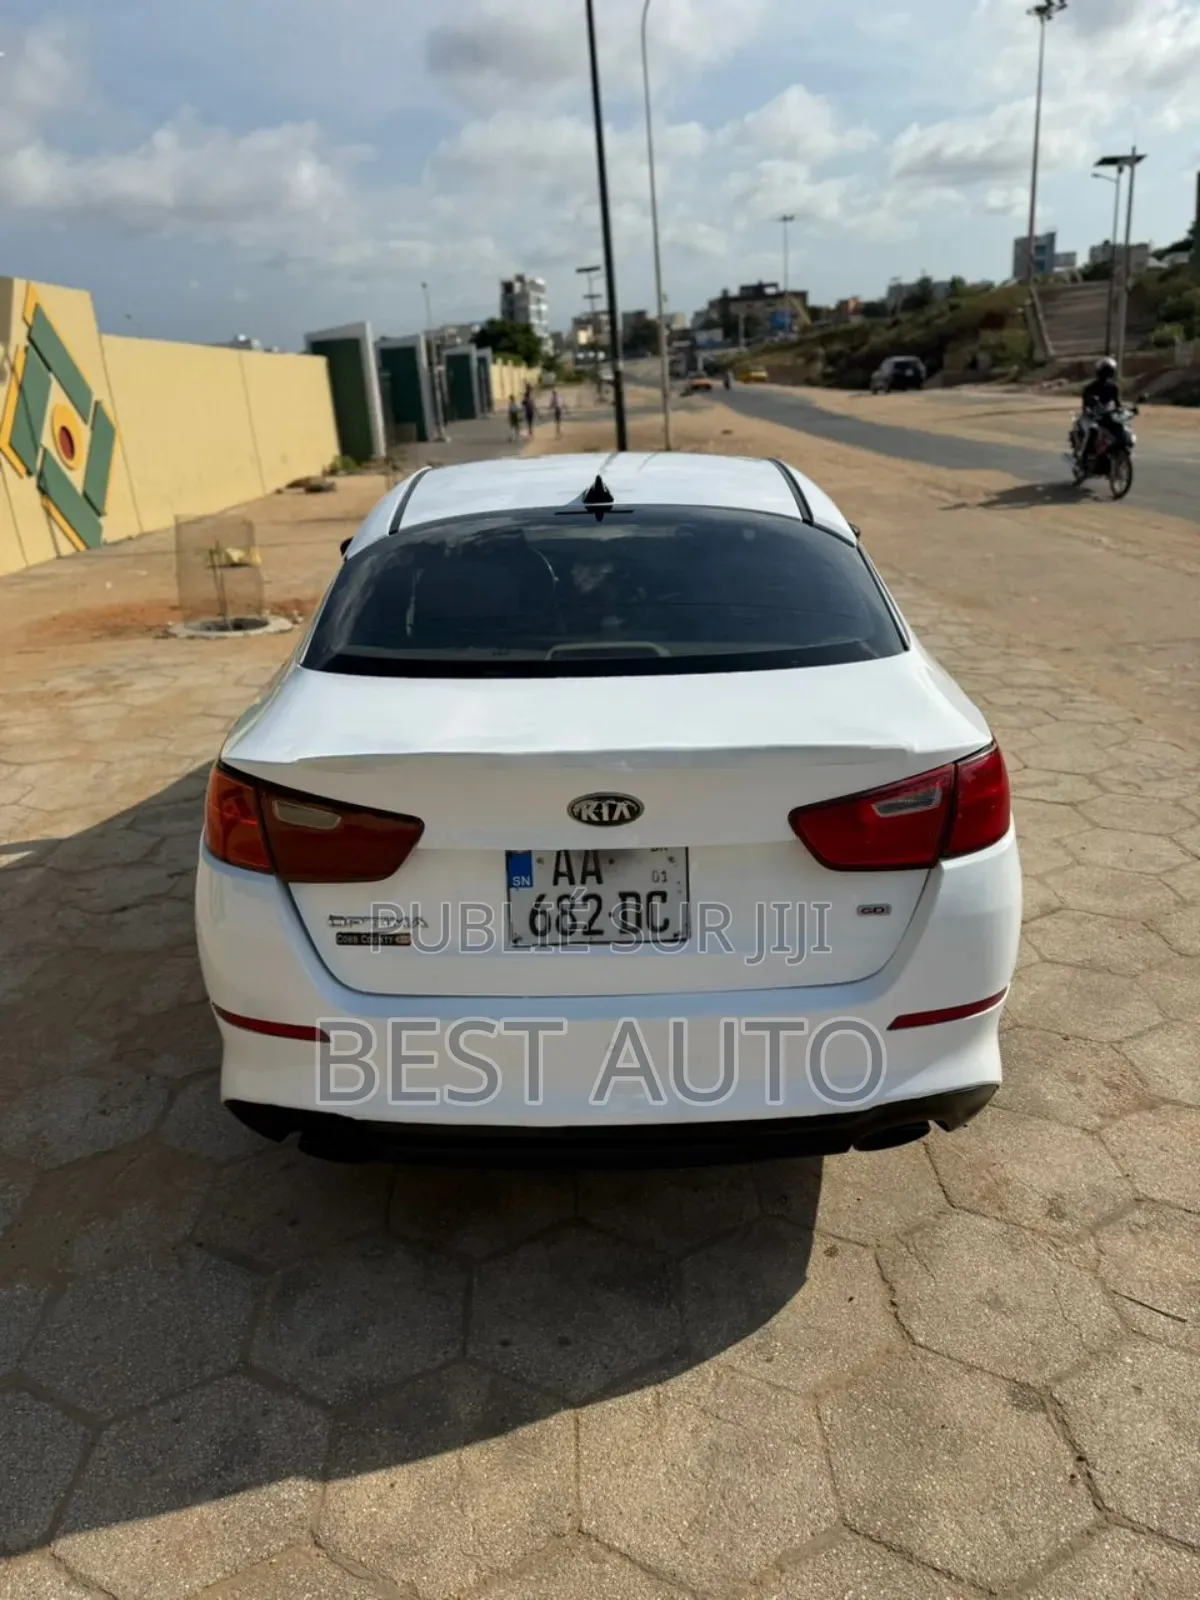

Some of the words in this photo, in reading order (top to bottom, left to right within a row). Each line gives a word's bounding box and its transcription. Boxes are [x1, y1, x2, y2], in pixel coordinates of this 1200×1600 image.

[571, 799, 633, 822] KIA
[513, 876, 531, 887] SN
[552, 849, 604, 887] AA
[528, 893, 605, 937] 682
[618, 891, 671, 936] DC
